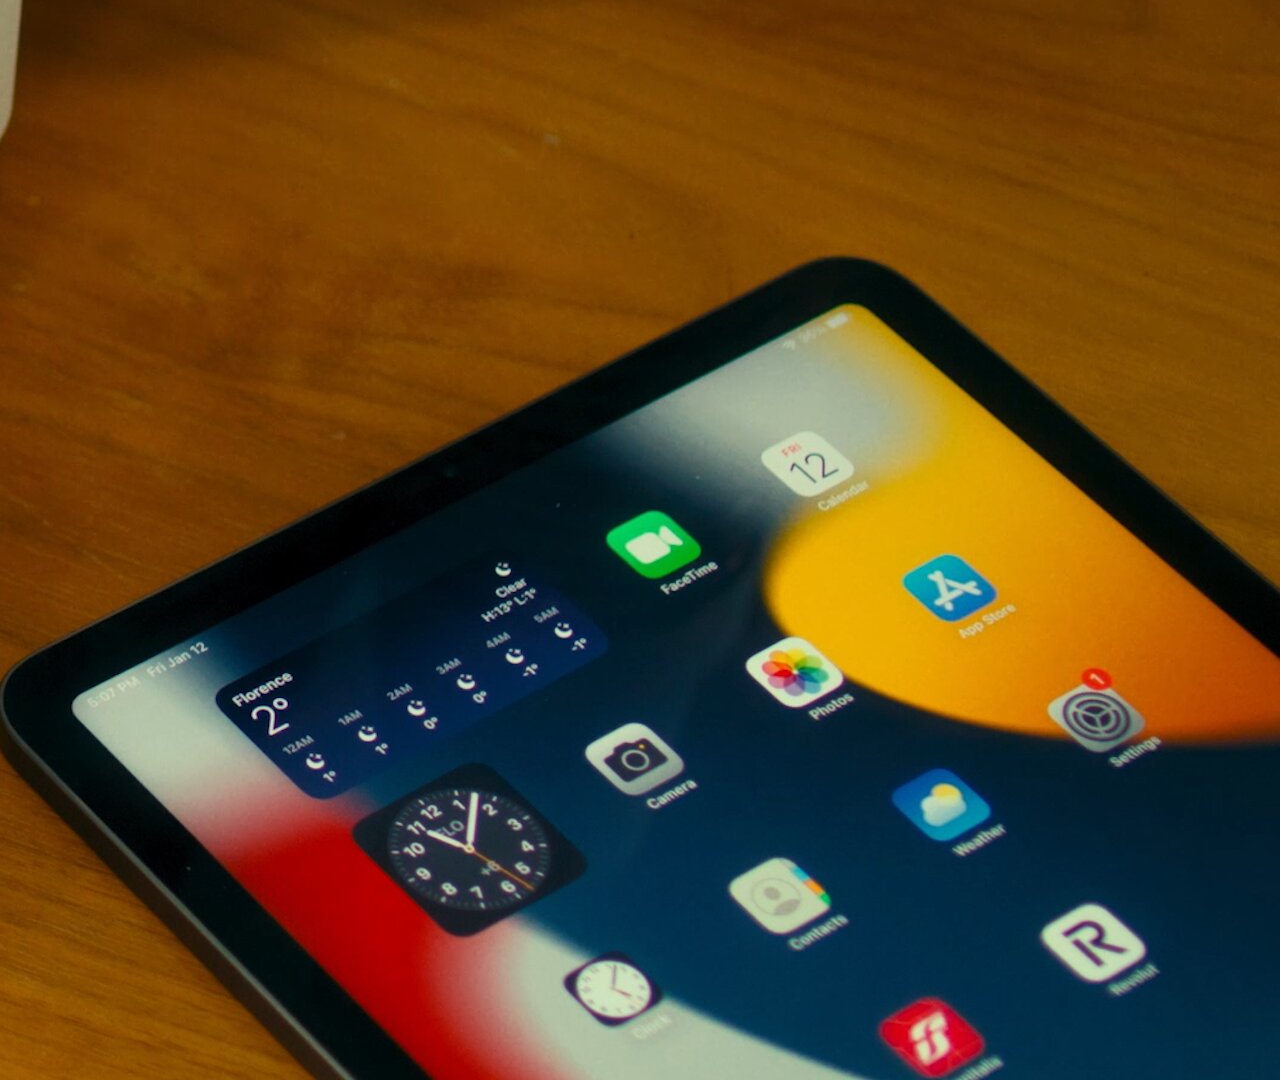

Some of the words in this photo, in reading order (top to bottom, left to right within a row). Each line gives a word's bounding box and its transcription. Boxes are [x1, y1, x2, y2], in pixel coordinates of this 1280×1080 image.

[781, 443, 802, 457] FRI
[790, 452, 839, 484] 12
[817, 480, 870, 512] Calendar
[660, 560, 718, 595] FaceTime
[495, 577, 528, 598] Clear
[958, 618, 985, 639] App
[983, 604, 1016, 627] Store
[146, 662, 167, 678] Fri
[168, 651, 191, 668] Jan
[190, 641, 209, 656] 12
[282, 735, 315, 755] 12AM
[338, 709, 363, 726] 1AM
[386, 683, 414, 701] 2AM
[435, 657, 462, 675] 3AM
[486, 631, 512, 649] 4AM
[533, 606, 560, 624] 5AM
[1089, 672, 1105, 685] 1
[232, 672, 293, 707] Florence
[808, 692, 854, 721] Photos
[251, 697, 290, 736] 2°
[1109, 735, 1161, 769] Settings
[646, 779, 698, 810] Camera
[420, 804, 443, 820] 12
[453, 799, 466, 811] 1
[482, 803, 498, 816] 2
[407, 821, 427, 835] 11
[507, 818, 522, 831] 3
[521, 840, 534, 852] 4
[952, 823, 1006, 858] Weather
[403, 843, 425, 858] 10
[416, 867, 431, 880] 9
[515, 862, 531, 874] 5
[441, 882, 457, 896] 8
[470, 886, 483, 899] 7
[500, 880, 516, 893] 6
[787, 914, 848, 951] Contacts
